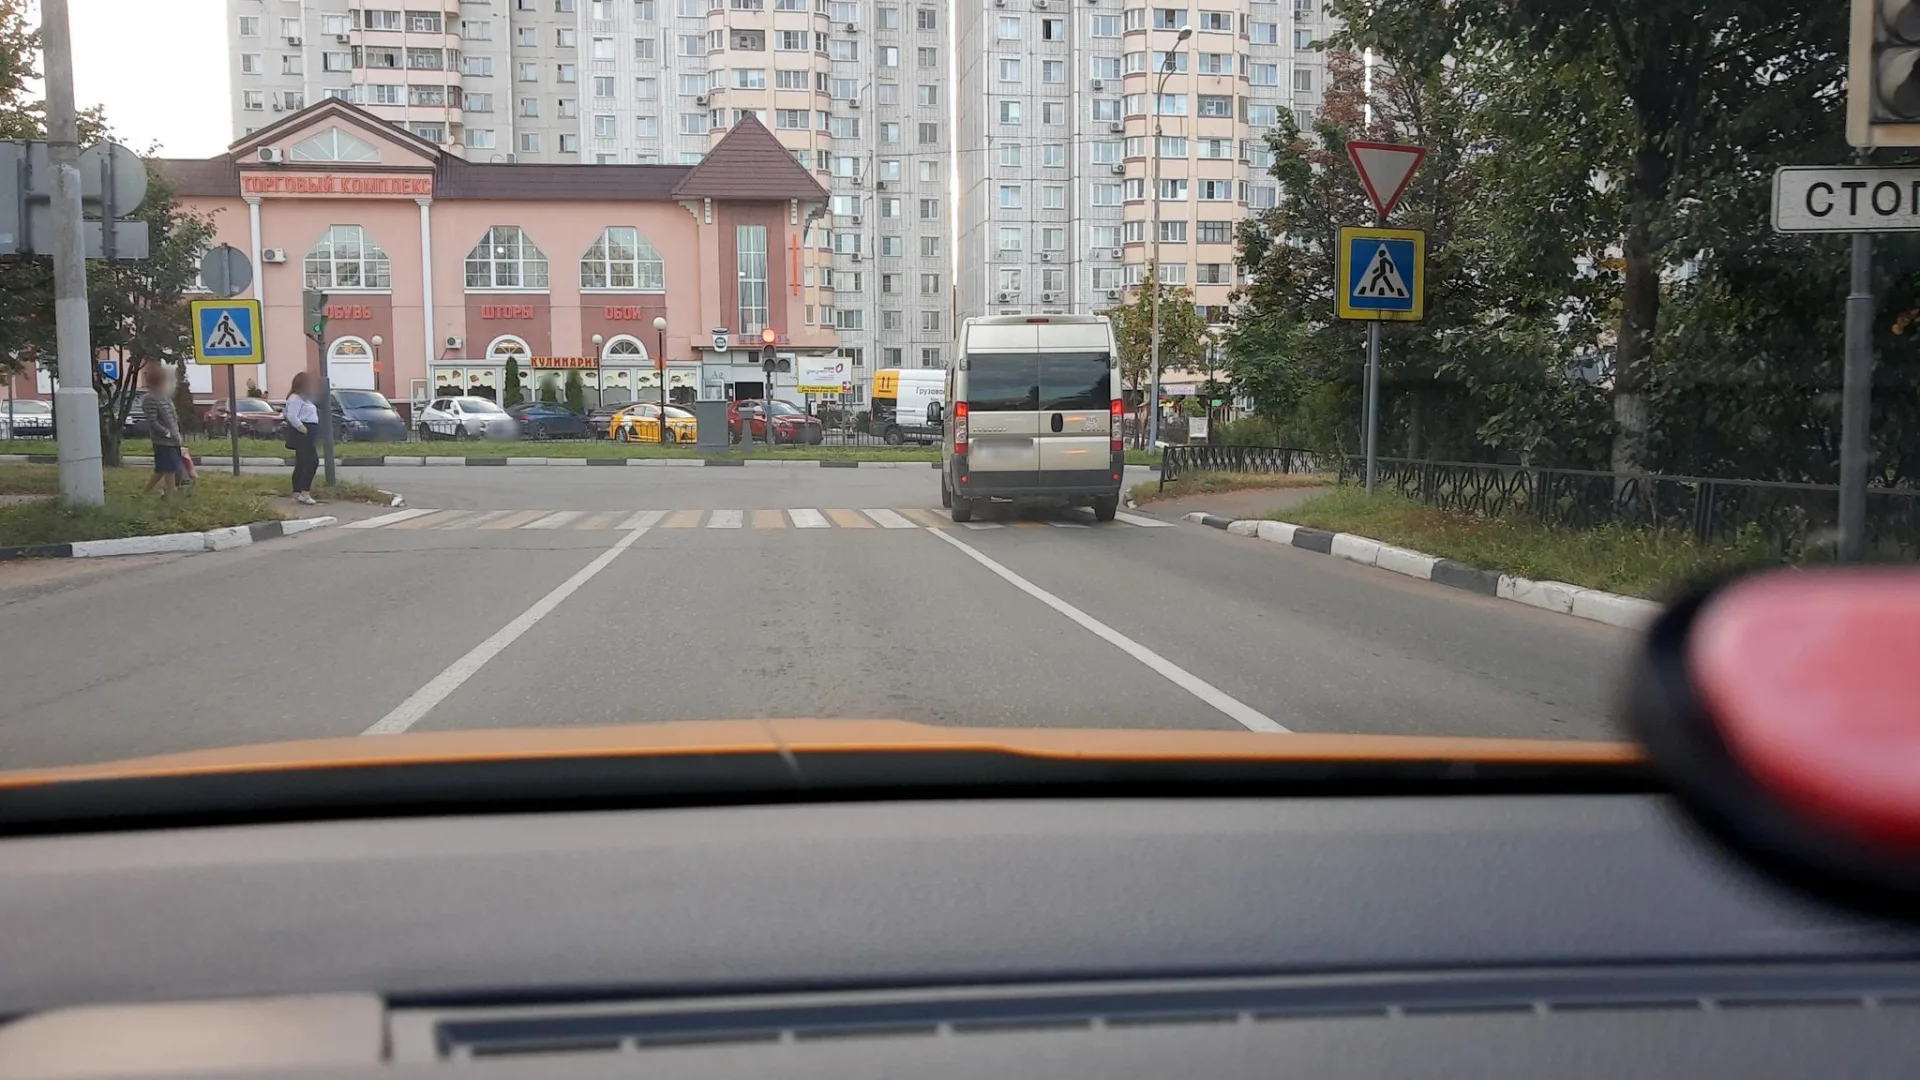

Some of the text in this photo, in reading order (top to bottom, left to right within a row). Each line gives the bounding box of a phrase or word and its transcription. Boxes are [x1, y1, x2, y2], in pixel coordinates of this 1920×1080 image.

[242, 174, 431, 195] ТОРГОВЫЙ КОМПЛЕКС
[480, 304, 534, 320] ШТОРЫ
[604, 305, 642, 320] ОБОИ
[531, 357, 599, 368] КУЛИНАРИЯ
